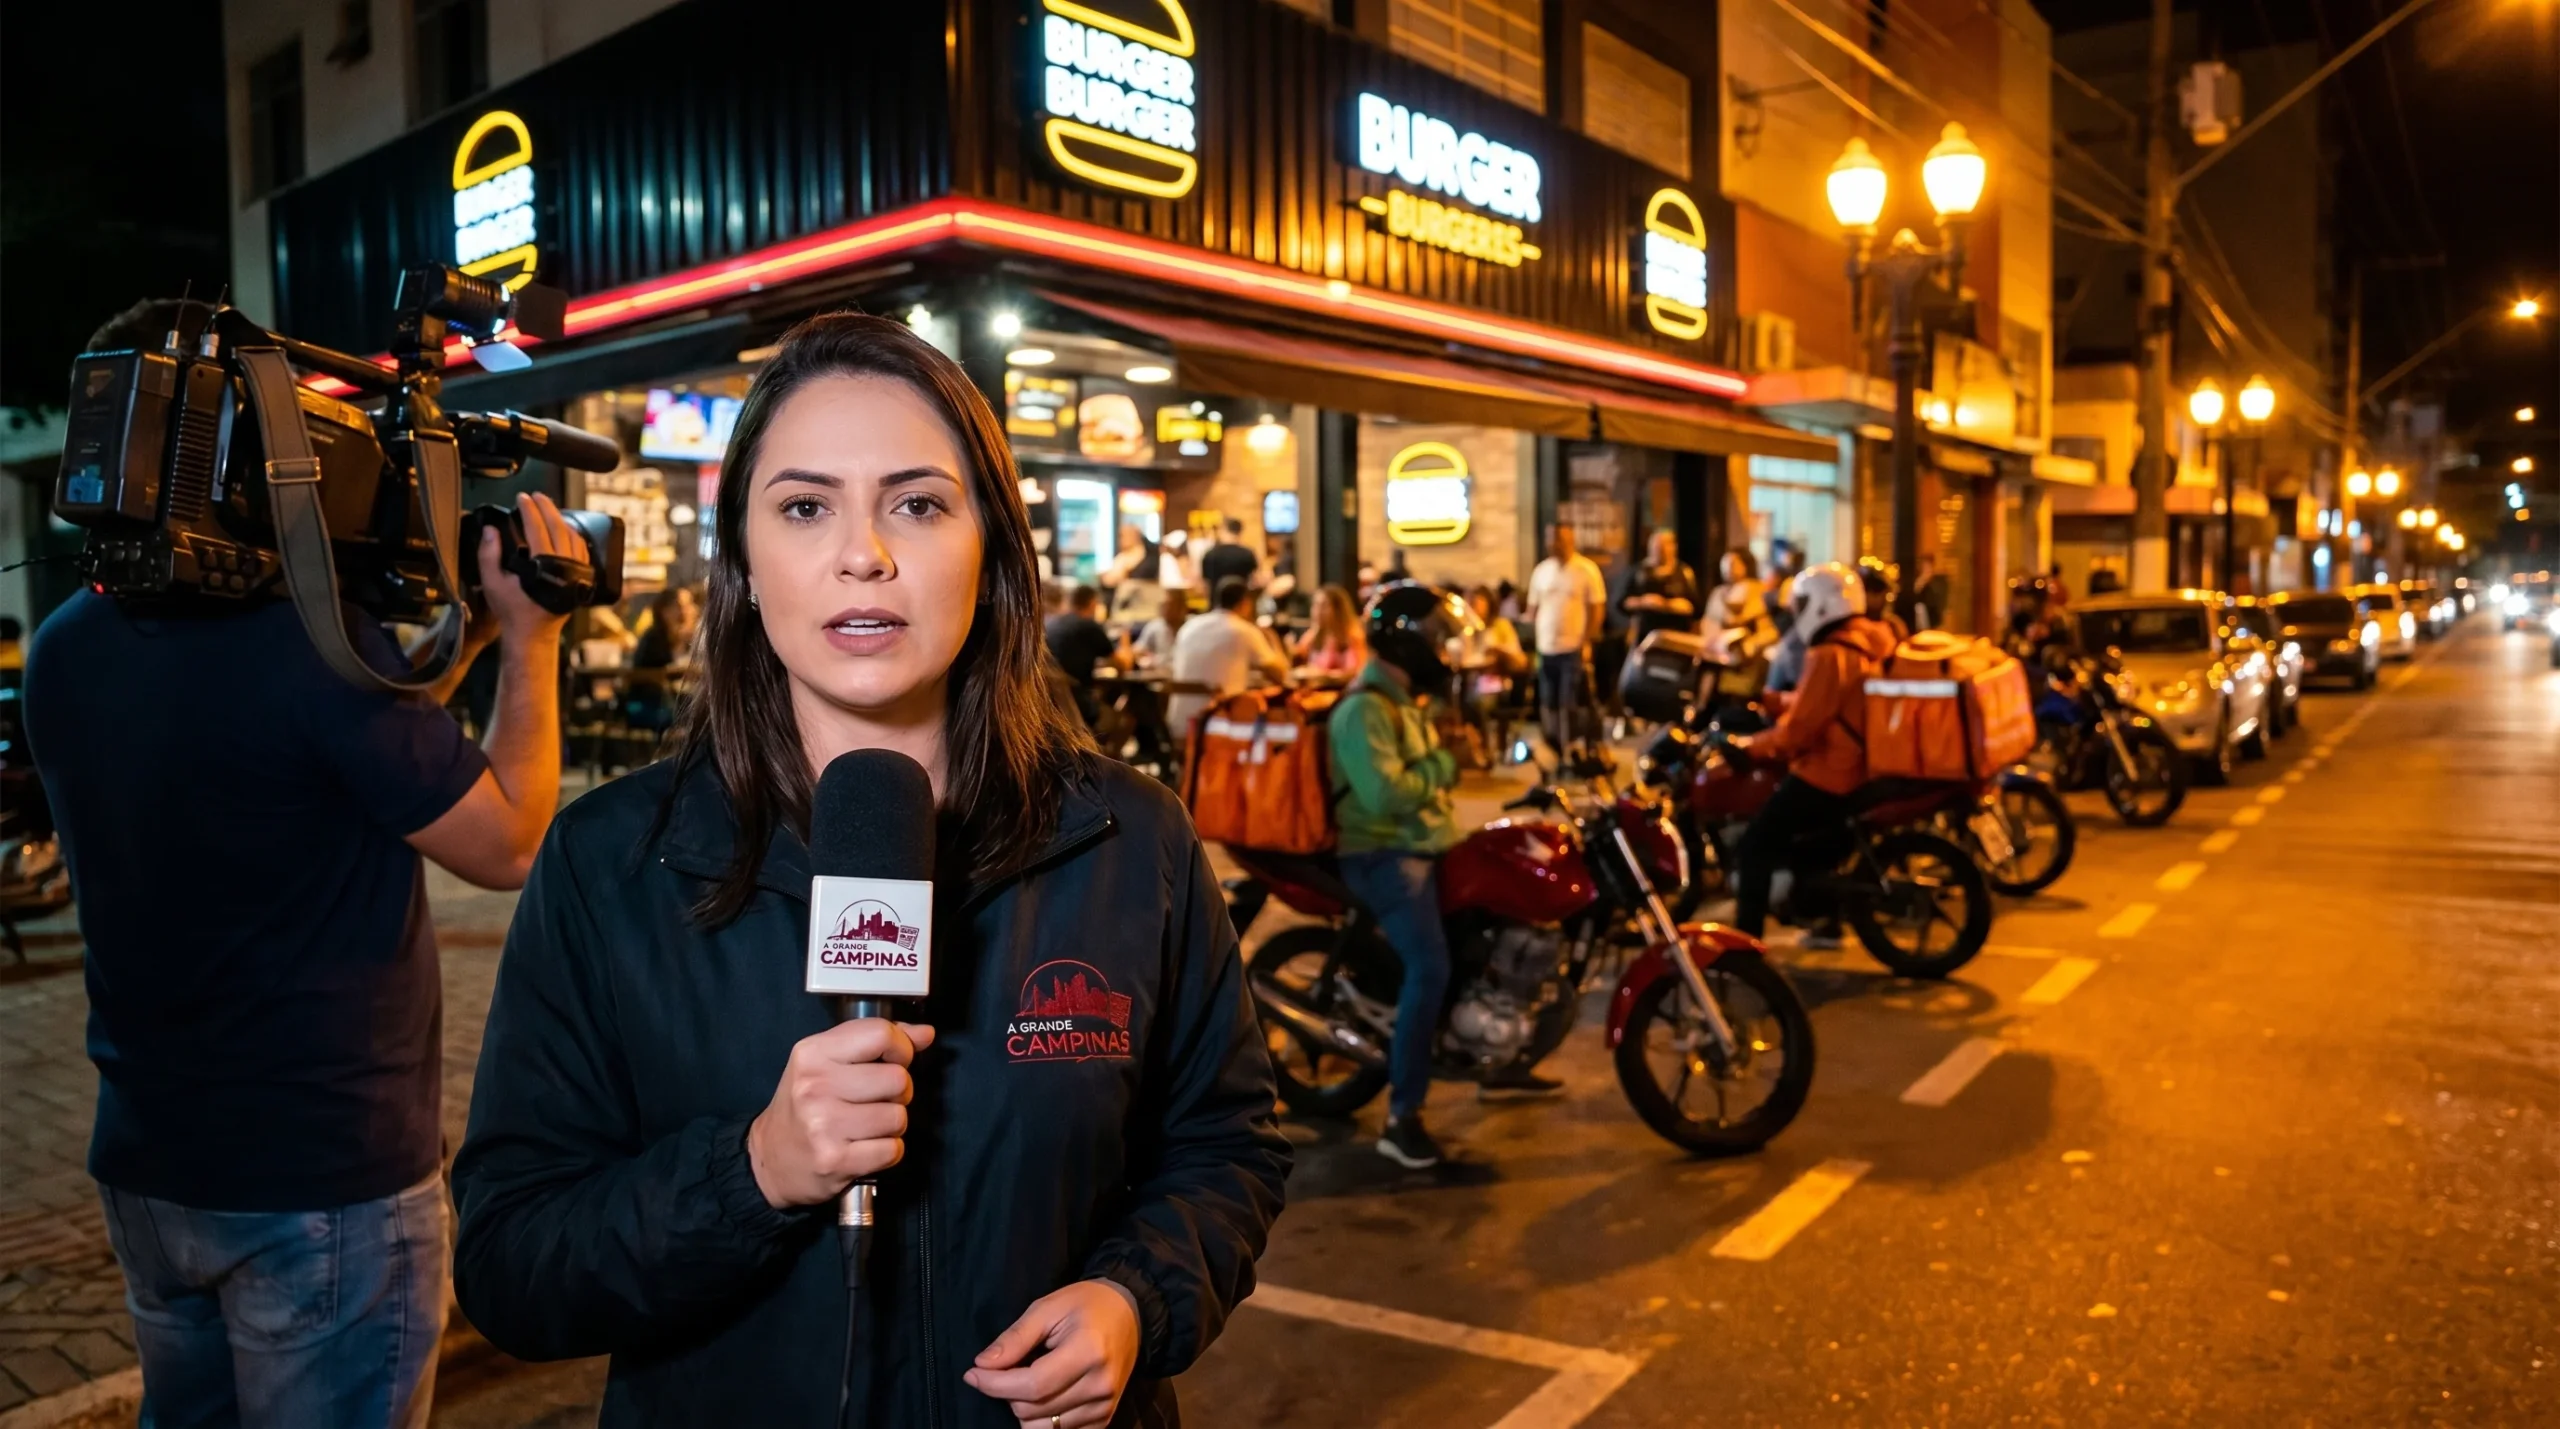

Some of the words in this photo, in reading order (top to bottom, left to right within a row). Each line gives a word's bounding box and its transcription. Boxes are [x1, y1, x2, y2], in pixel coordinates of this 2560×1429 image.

[1044, 15, 1195, 106] BURGER
[1045, 65, 1196, 152] BURGER
[1359, 92, 1541, 223] BURGER
[820, 950, 918, 967] CAMPINAS
[1007, 1023, 1017, 1034] A
[1020, 1020, 1073, 1033] GRANDE
[1007, 1031, 1130, 1056] CAMPINAS
